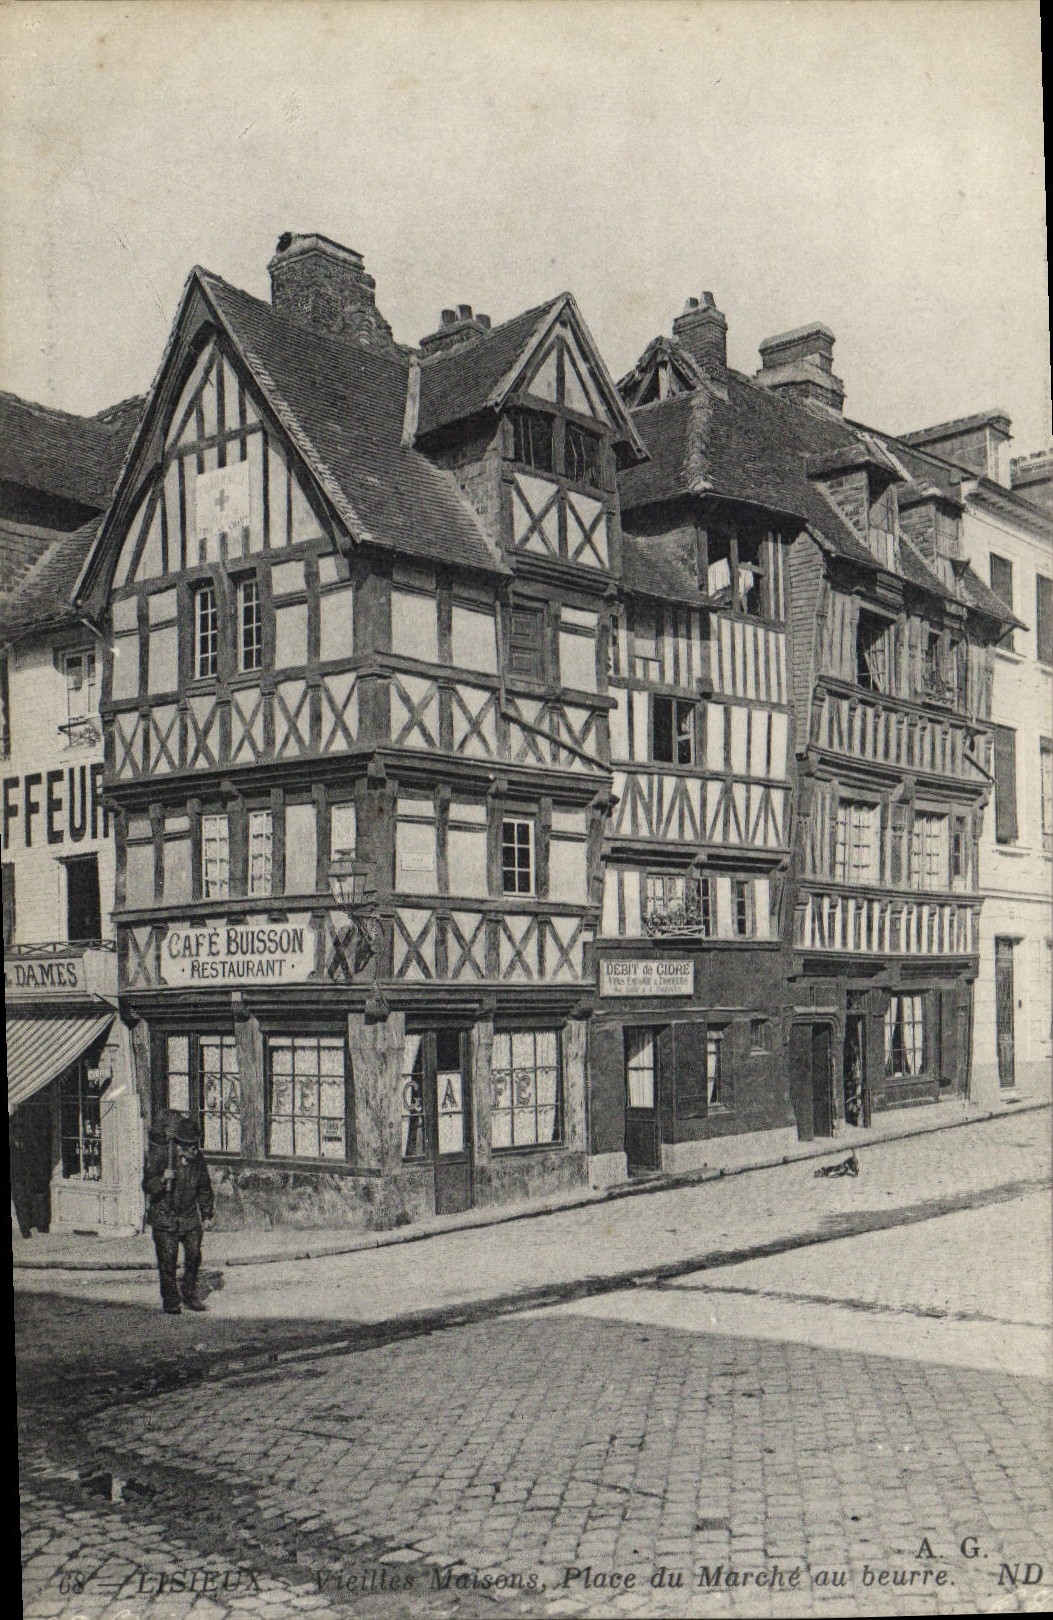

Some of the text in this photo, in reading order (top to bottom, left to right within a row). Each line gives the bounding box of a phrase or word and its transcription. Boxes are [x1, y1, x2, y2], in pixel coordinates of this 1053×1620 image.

[226, 928, 303, 956] BUISSON
[14, 962, 78, 988] DAMES
[190, 959, 286, 979] RESTAURANT
[656, 961, 691, 976] CIDRE
